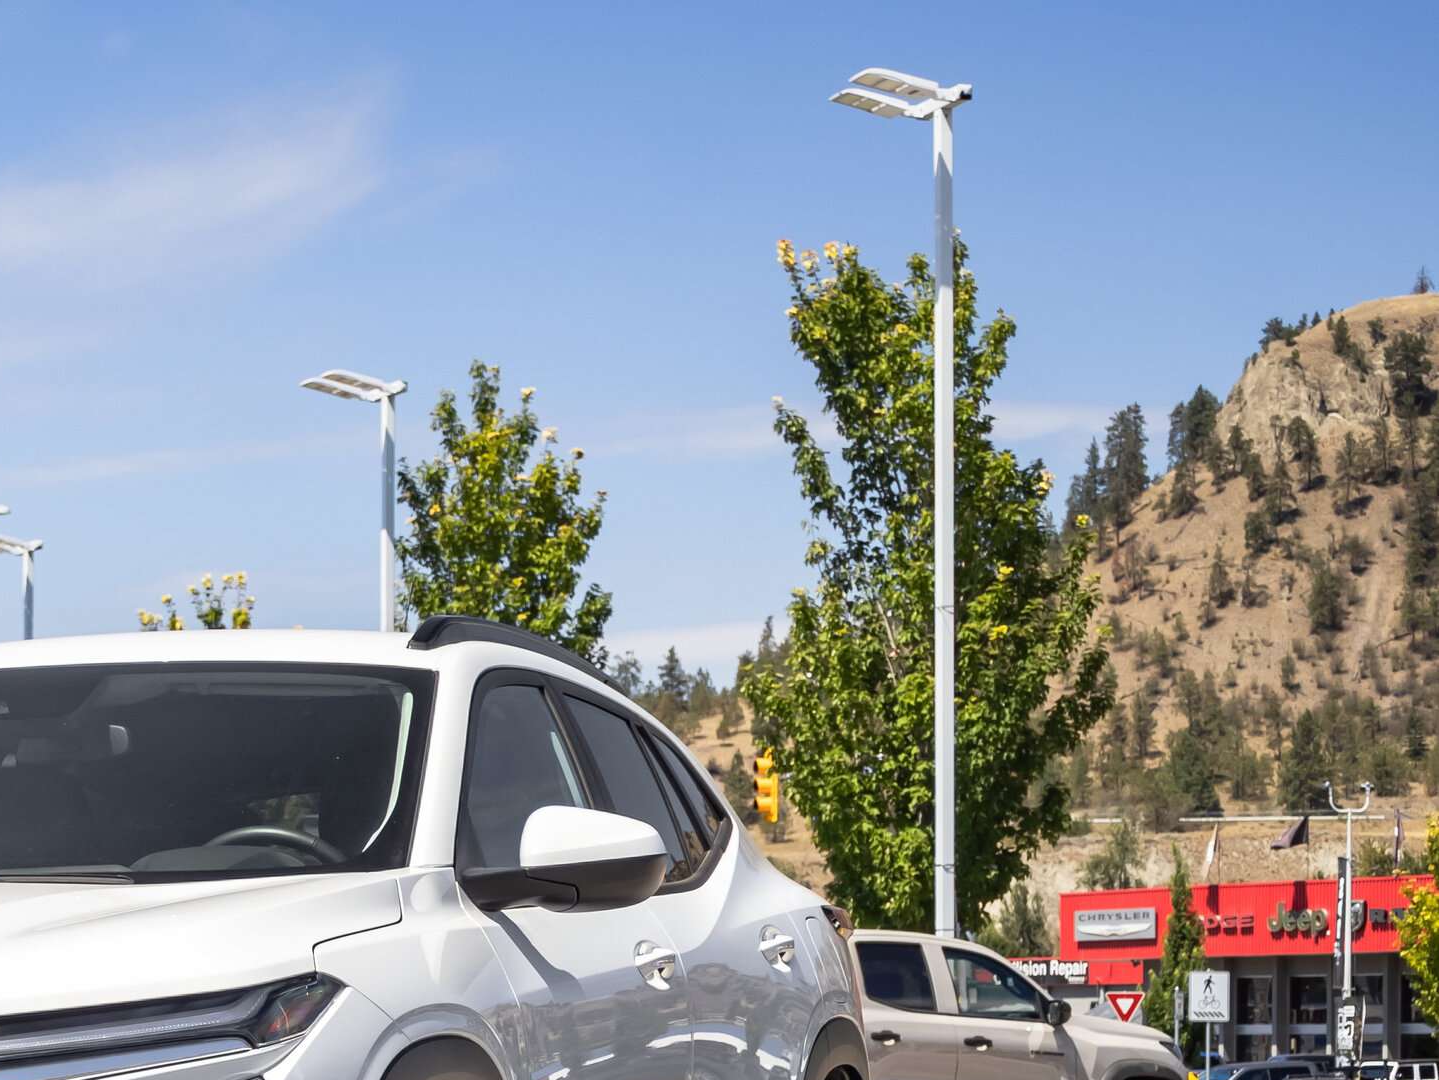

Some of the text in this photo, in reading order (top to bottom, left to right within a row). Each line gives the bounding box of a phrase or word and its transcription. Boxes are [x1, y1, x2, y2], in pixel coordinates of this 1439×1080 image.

[1078, 911, 1151, 922] CHRYSLER
[1267, 901, 1329, 937] Jeep
[1049, 960, 1088, 979] Repair
